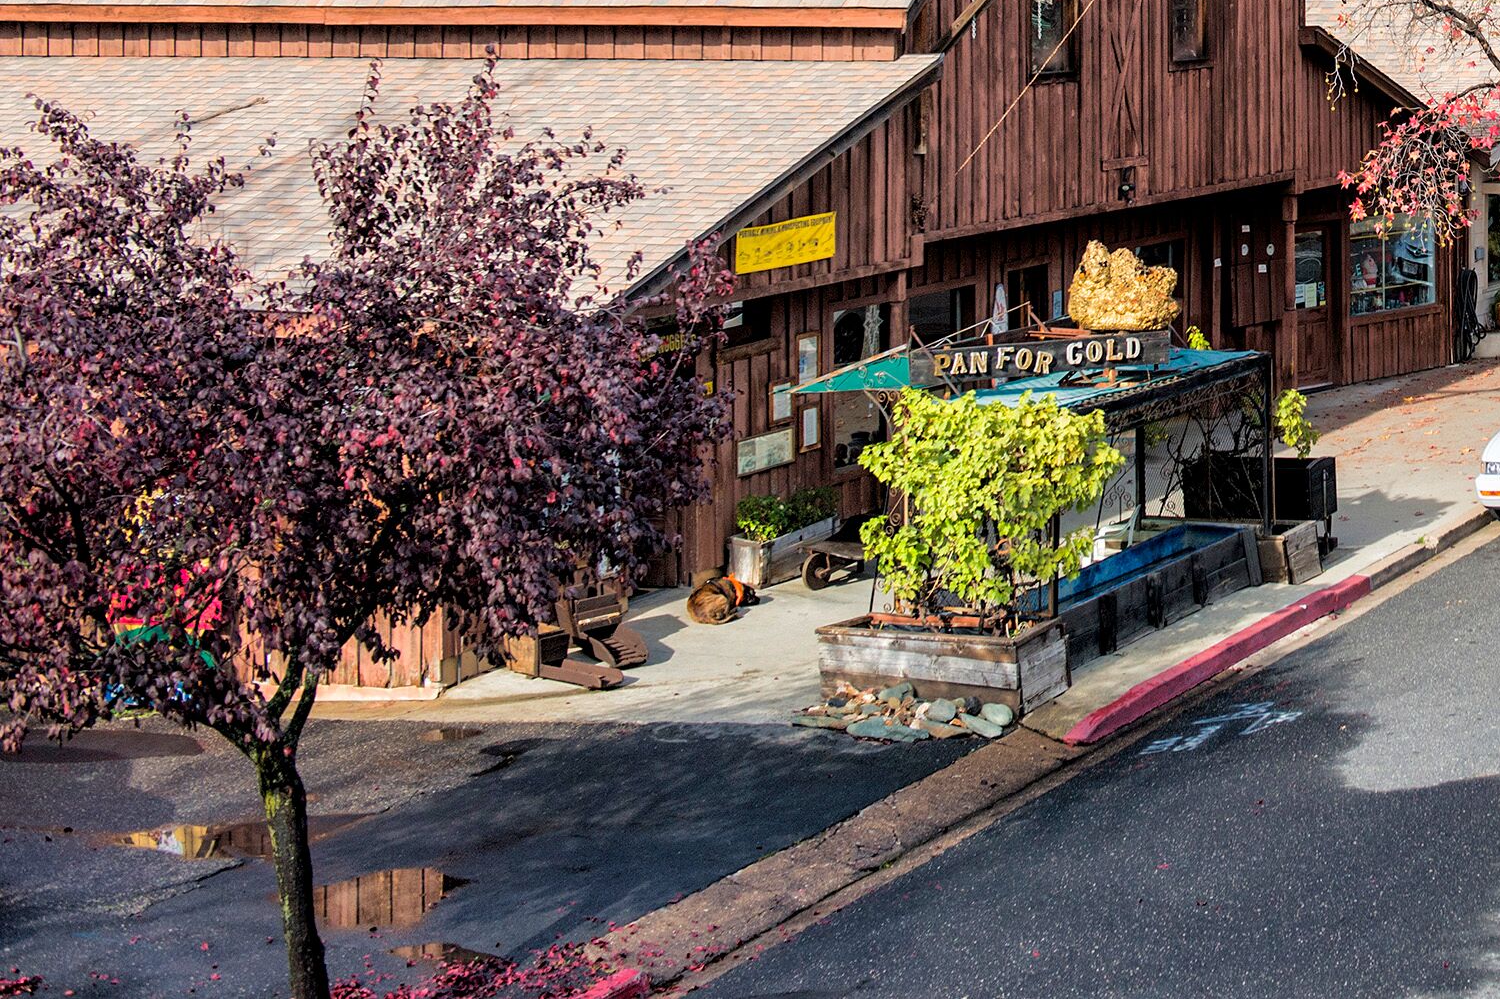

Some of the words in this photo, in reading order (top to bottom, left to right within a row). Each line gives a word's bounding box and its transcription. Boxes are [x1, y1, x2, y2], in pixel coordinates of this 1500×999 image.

[934, 351, 988, 376] PAN
[996, 347, 1054, 374] FOR
[1066, 337, 1142, 365] GOLD
